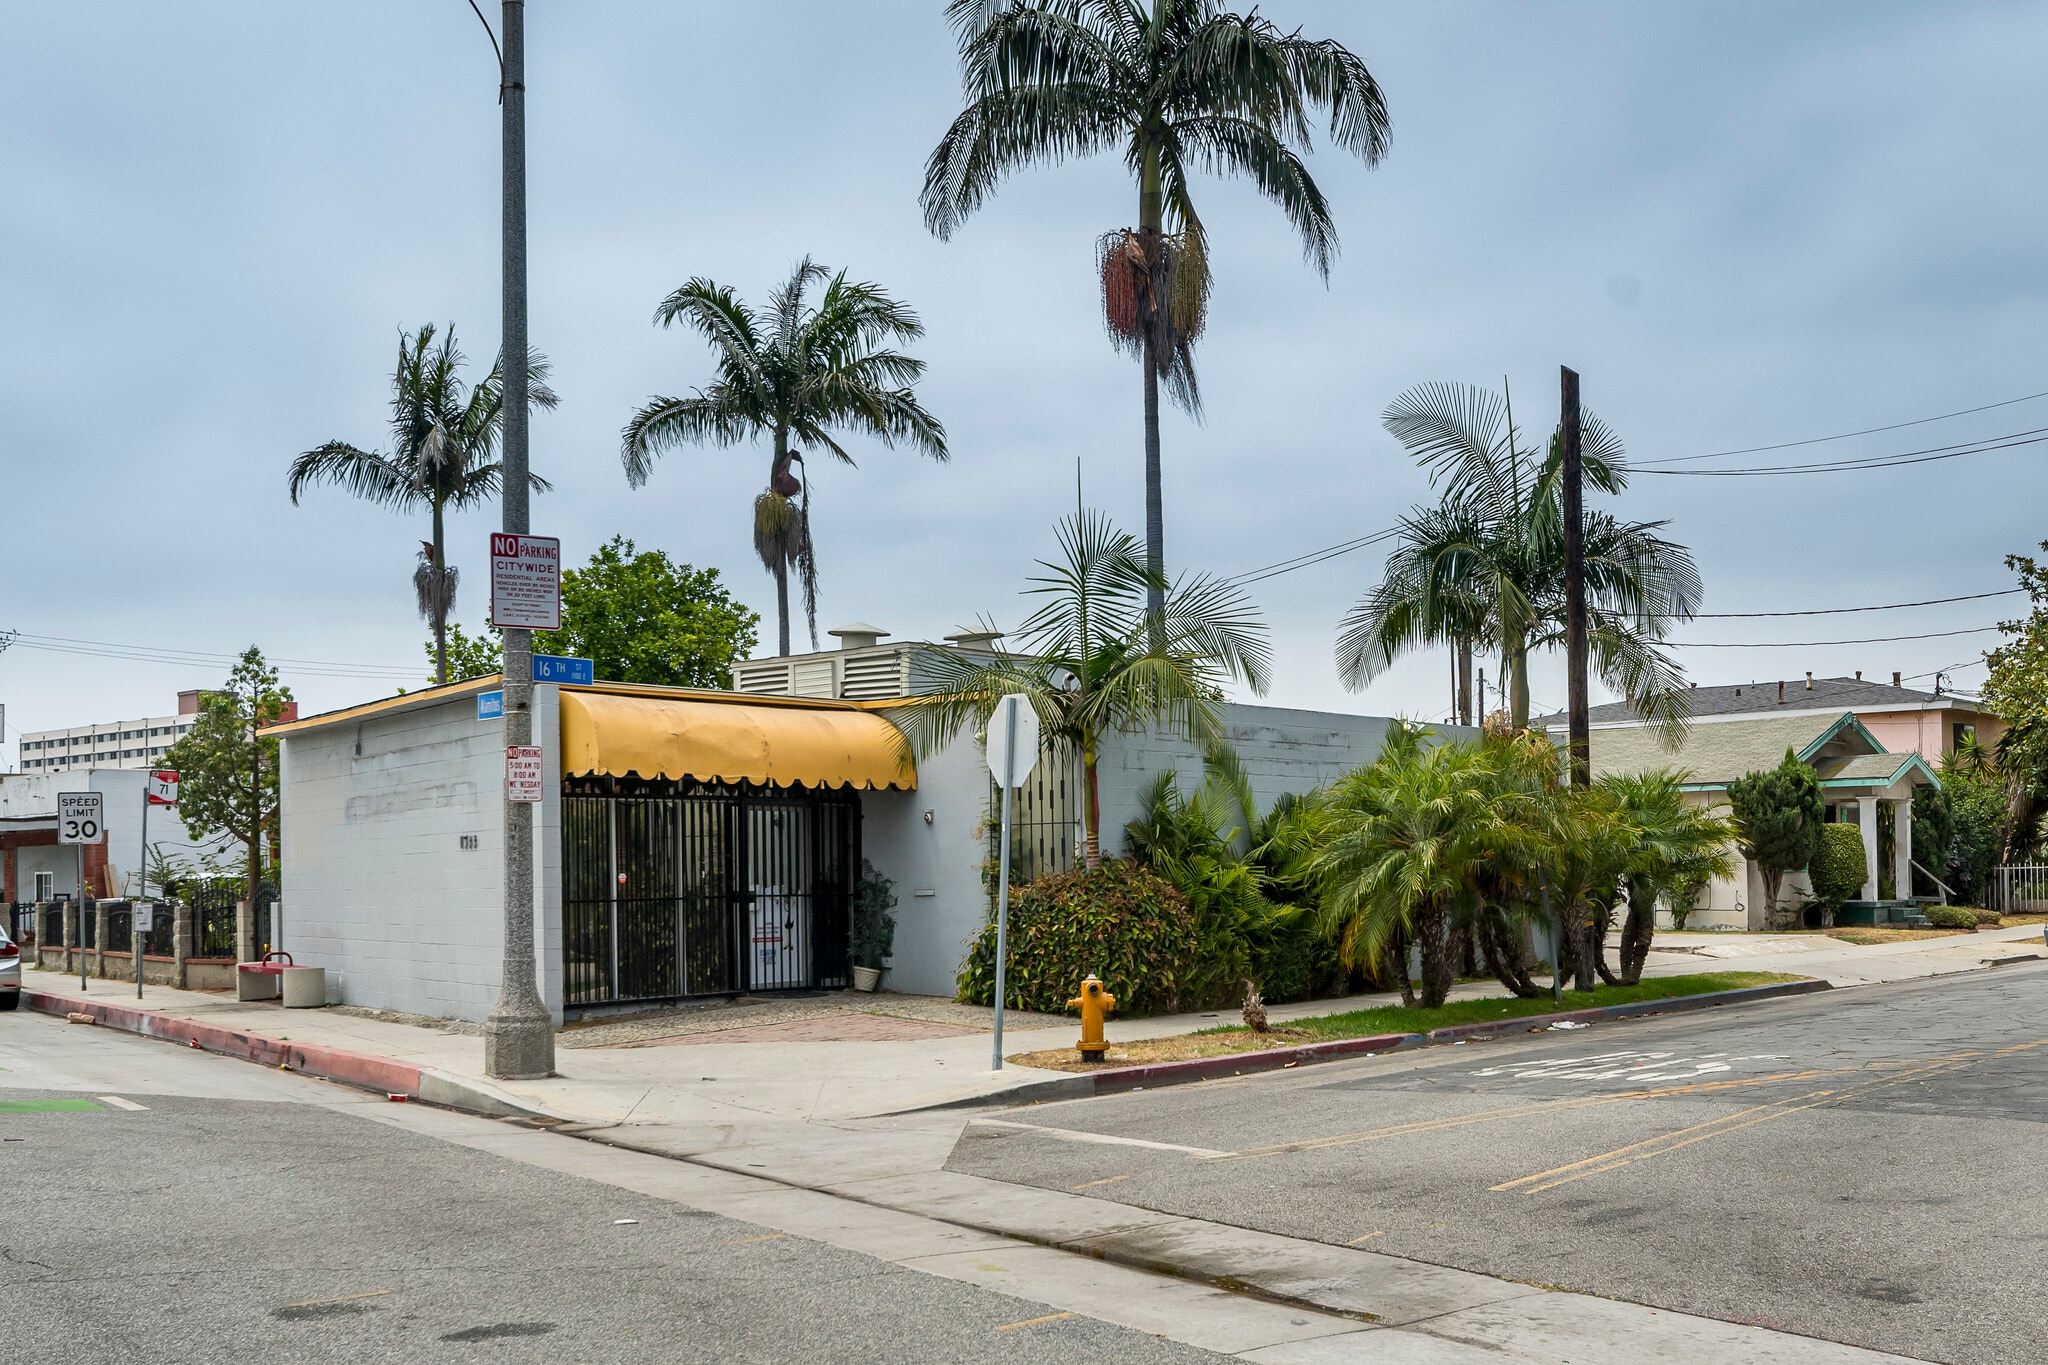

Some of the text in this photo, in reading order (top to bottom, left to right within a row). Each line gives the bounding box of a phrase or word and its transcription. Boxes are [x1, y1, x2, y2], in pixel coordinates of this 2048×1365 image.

[494, 537, 556, 560] NO PARKING
[496, 561, 554, 573] CITYWIDE
[496, 573, 533, 581] RESIDENTIAL
[539, 661, 551, 676] 16
[556, 662, 566, 673] TH
[508, 748, 541, 758] NO PARKING
[159, 784, 169, 795] 71
[62, 798, 99, 806] SPEED
[66, 808, 95, 817] LIMIT
[65, 820, 97, 839] 30
